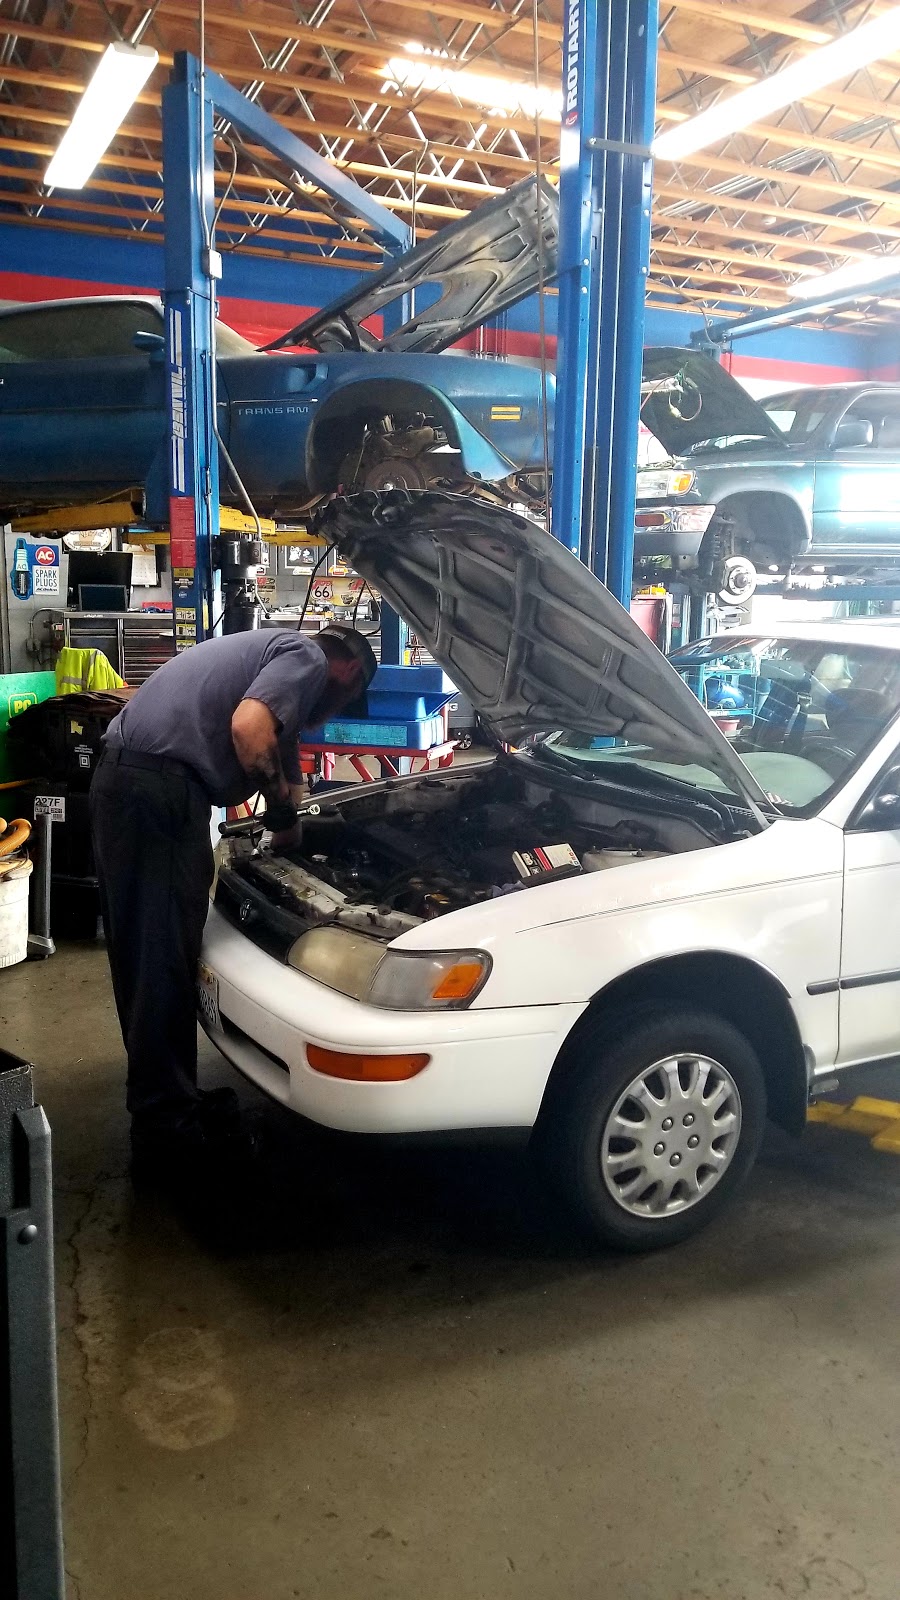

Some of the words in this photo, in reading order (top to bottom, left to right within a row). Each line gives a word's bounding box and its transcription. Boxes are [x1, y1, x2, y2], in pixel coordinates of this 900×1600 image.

[237, 407, 283, 416] TRANS
[286, 406, 309, 414] AM
[37, 550, 53, 561] AC
[35, 569, 57, 578] SPARK
[35, 578, 58, 587] PLUGS
[315, 586, 330, 598] 66
